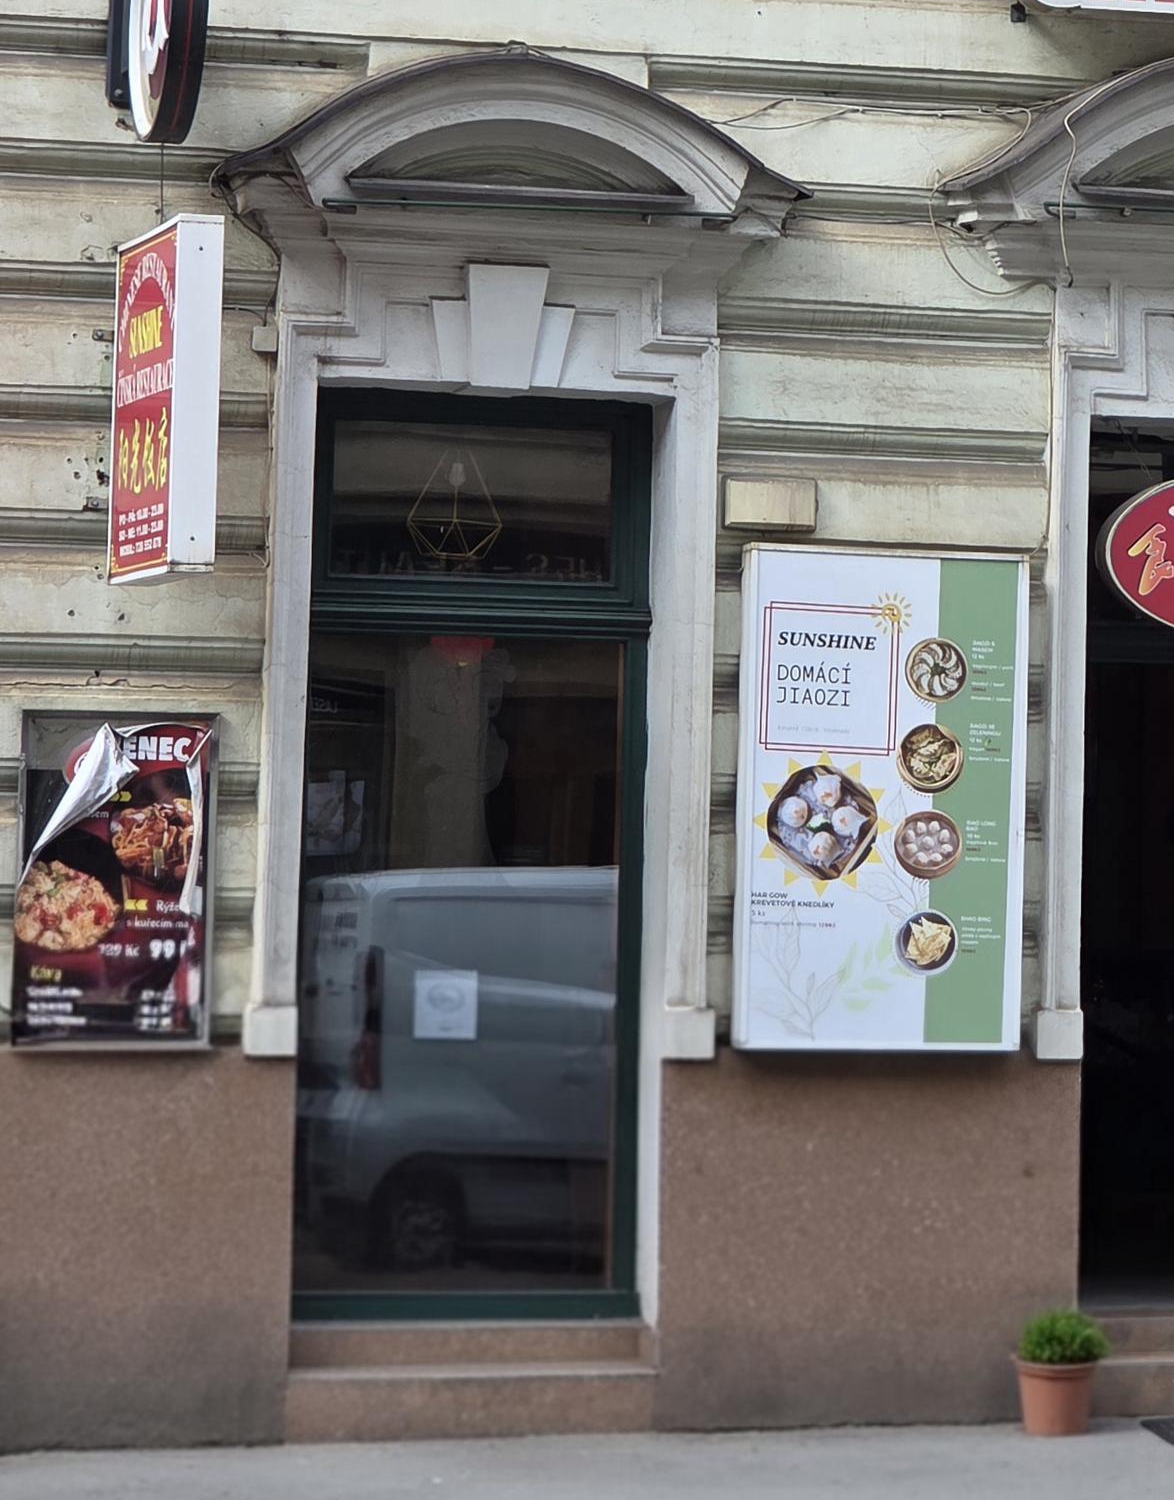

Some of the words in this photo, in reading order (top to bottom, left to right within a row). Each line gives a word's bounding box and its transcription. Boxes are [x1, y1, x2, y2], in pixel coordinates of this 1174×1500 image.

[778, 631, 877, 650] SUNSHINE
[777, 660, 852, 685] DOMÁCÍ
[776, 686, 851, 707] JIAOZI
[149, 938, 176, 960] 99
